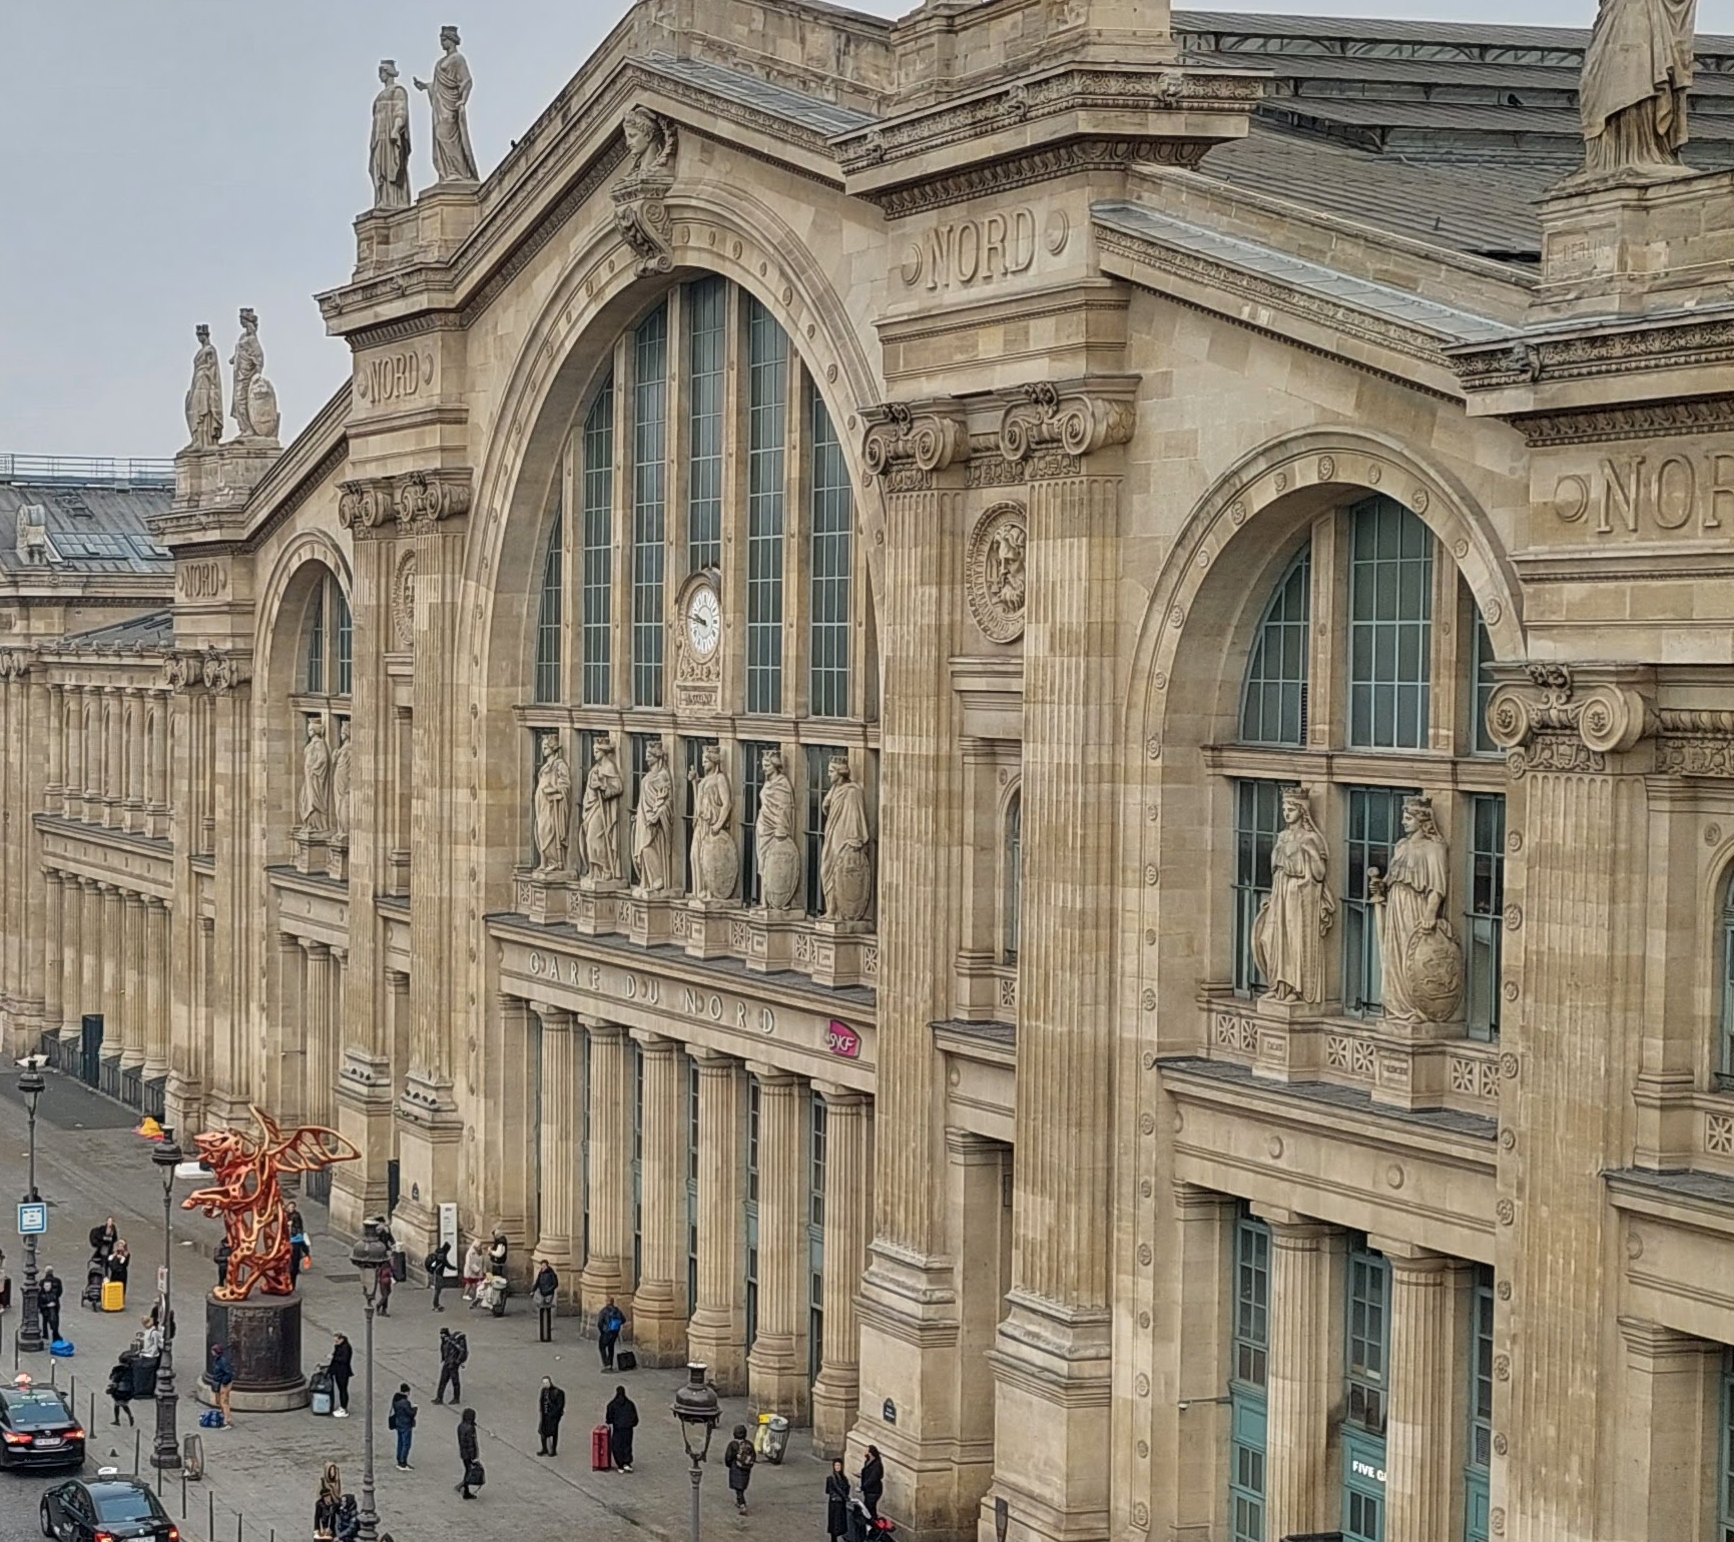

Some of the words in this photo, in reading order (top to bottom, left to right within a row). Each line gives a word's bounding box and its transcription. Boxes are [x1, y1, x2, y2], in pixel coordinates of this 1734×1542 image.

[927, 207, 1035, 290] NORD
[370, 351, 420, 404] NORD
[1596, 453, 1734, 534] NOR
[185, 562, 219, 597] NORD
[529, 951, 600, 990] GARE
[626, 975, 659, 1004] DU
[684, 987, 774, 1034] NORD
[829, 1032, 856, 1052] SNCF
[1353, 1460, 1375, 1478] FIVE
